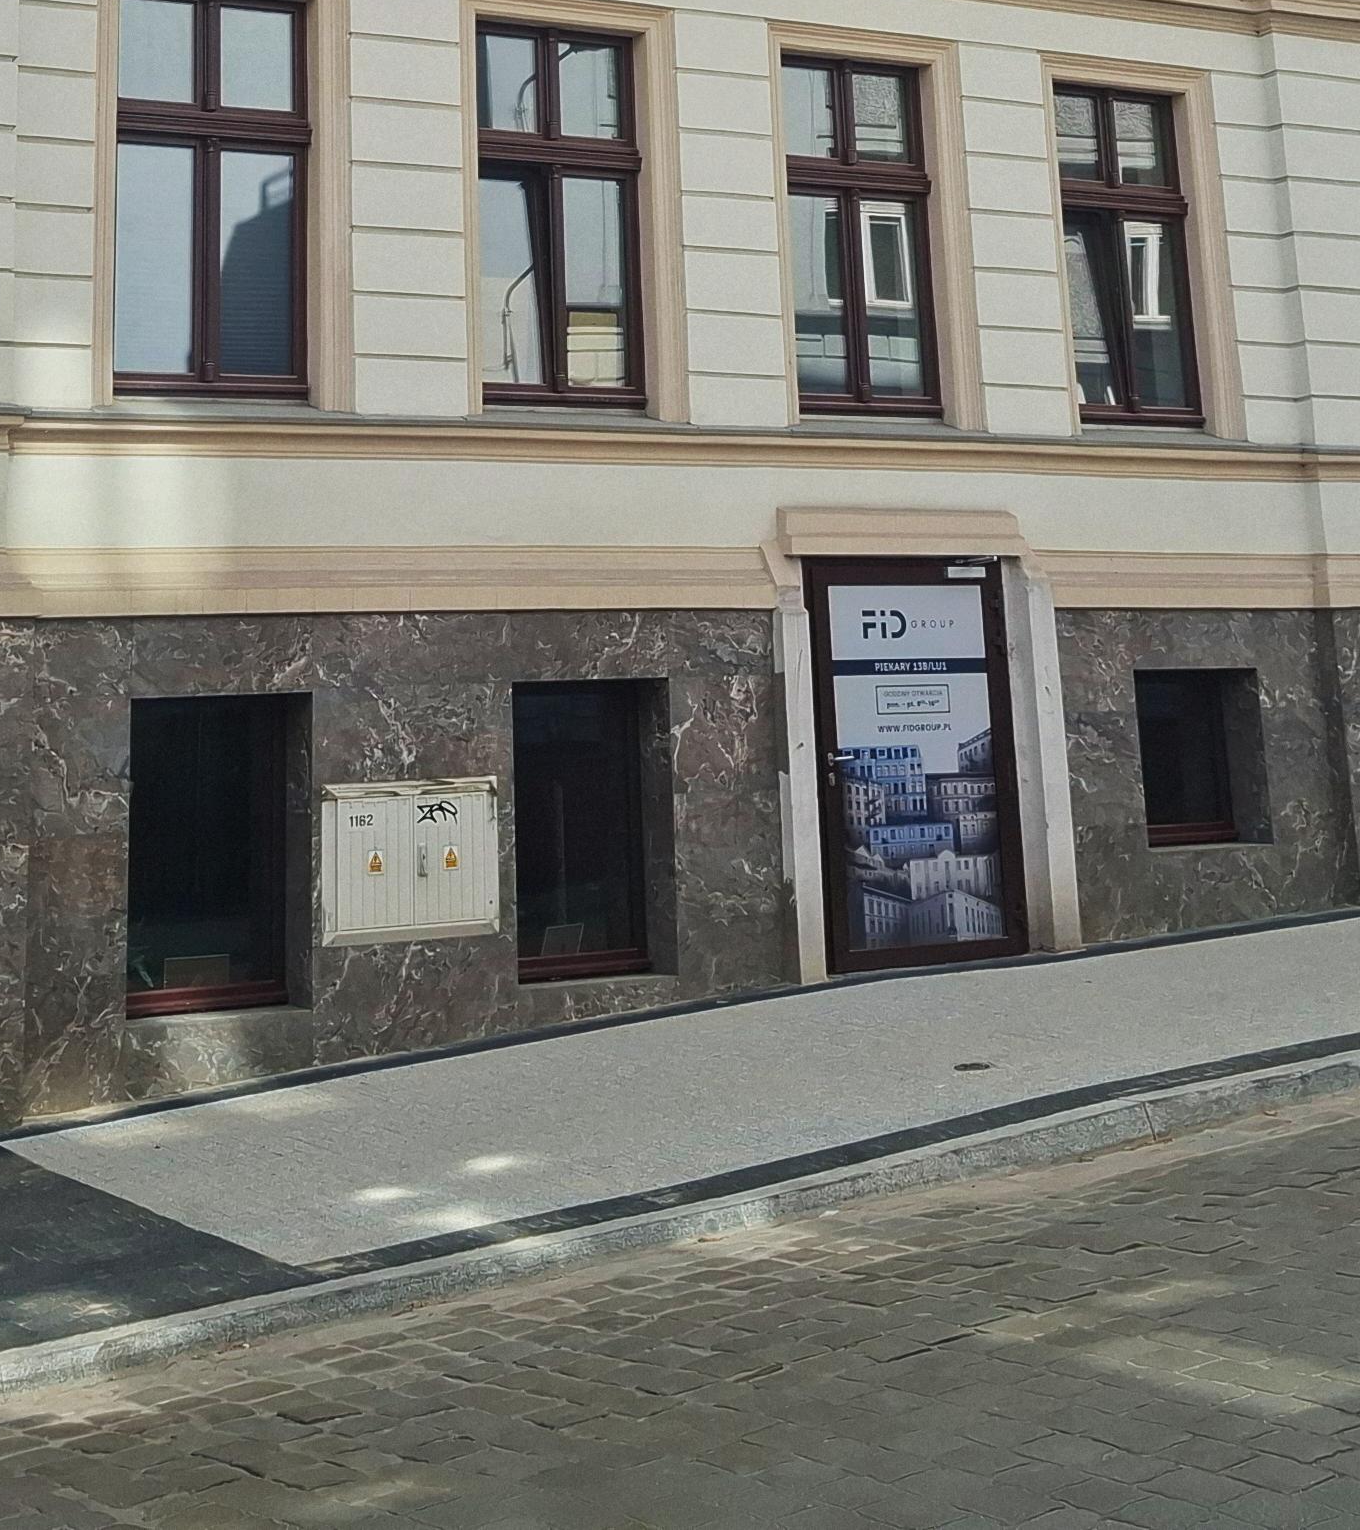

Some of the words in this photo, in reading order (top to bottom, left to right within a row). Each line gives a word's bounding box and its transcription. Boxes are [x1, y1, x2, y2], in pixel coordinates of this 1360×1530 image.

[910, 619, 955, 629] GROUP
[874, 661, 911, 672] PIEKARY
[877, 723, 952, 733] WWW.FIDGROUP.PL
[349, 814, 374, 828] 1162
